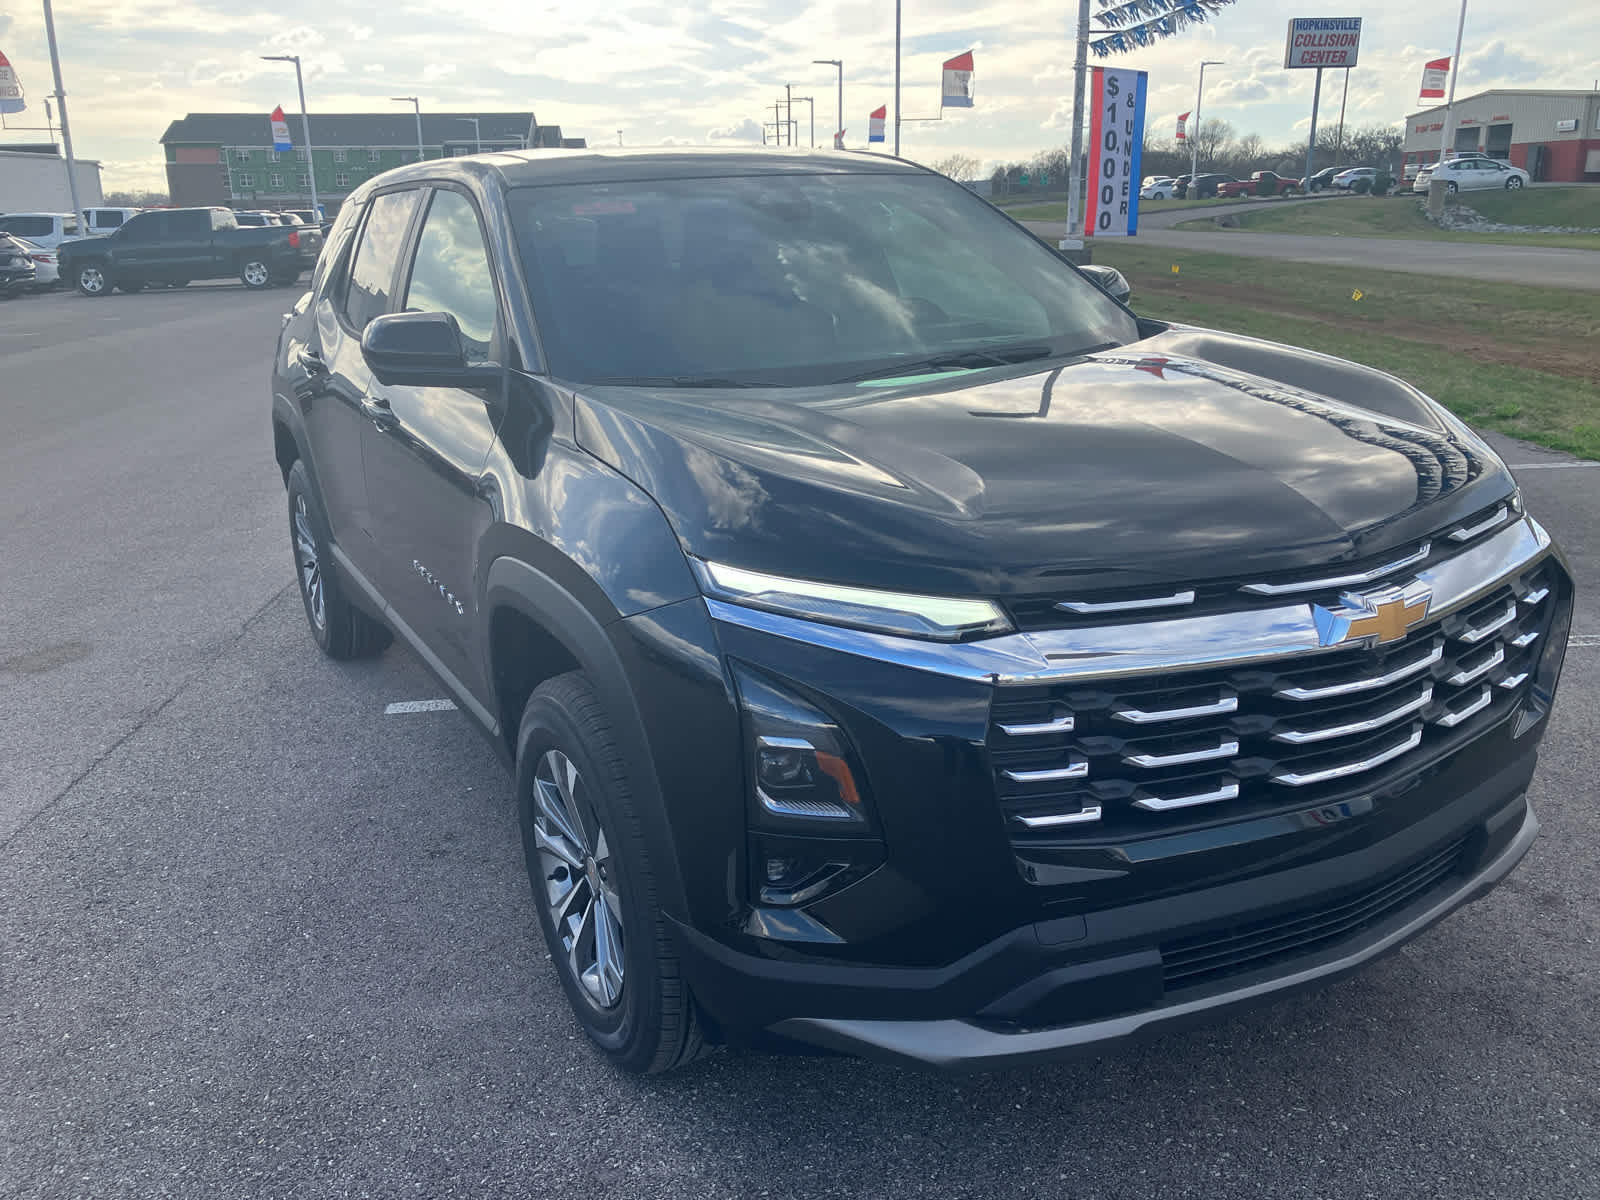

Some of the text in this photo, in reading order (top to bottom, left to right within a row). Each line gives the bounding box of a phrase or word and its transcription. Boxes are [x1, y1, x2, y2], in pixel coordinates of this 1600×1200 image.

[1295, 19, 1359, 31] HOPKINSVILLE
[1294, 33, 1358, 47] COLLISION
[1301, 50, 1347, 64] CENTER
[1100, 75, 1119, 230] $10,000
[1119, 93, 1134, 215] & UNDER
